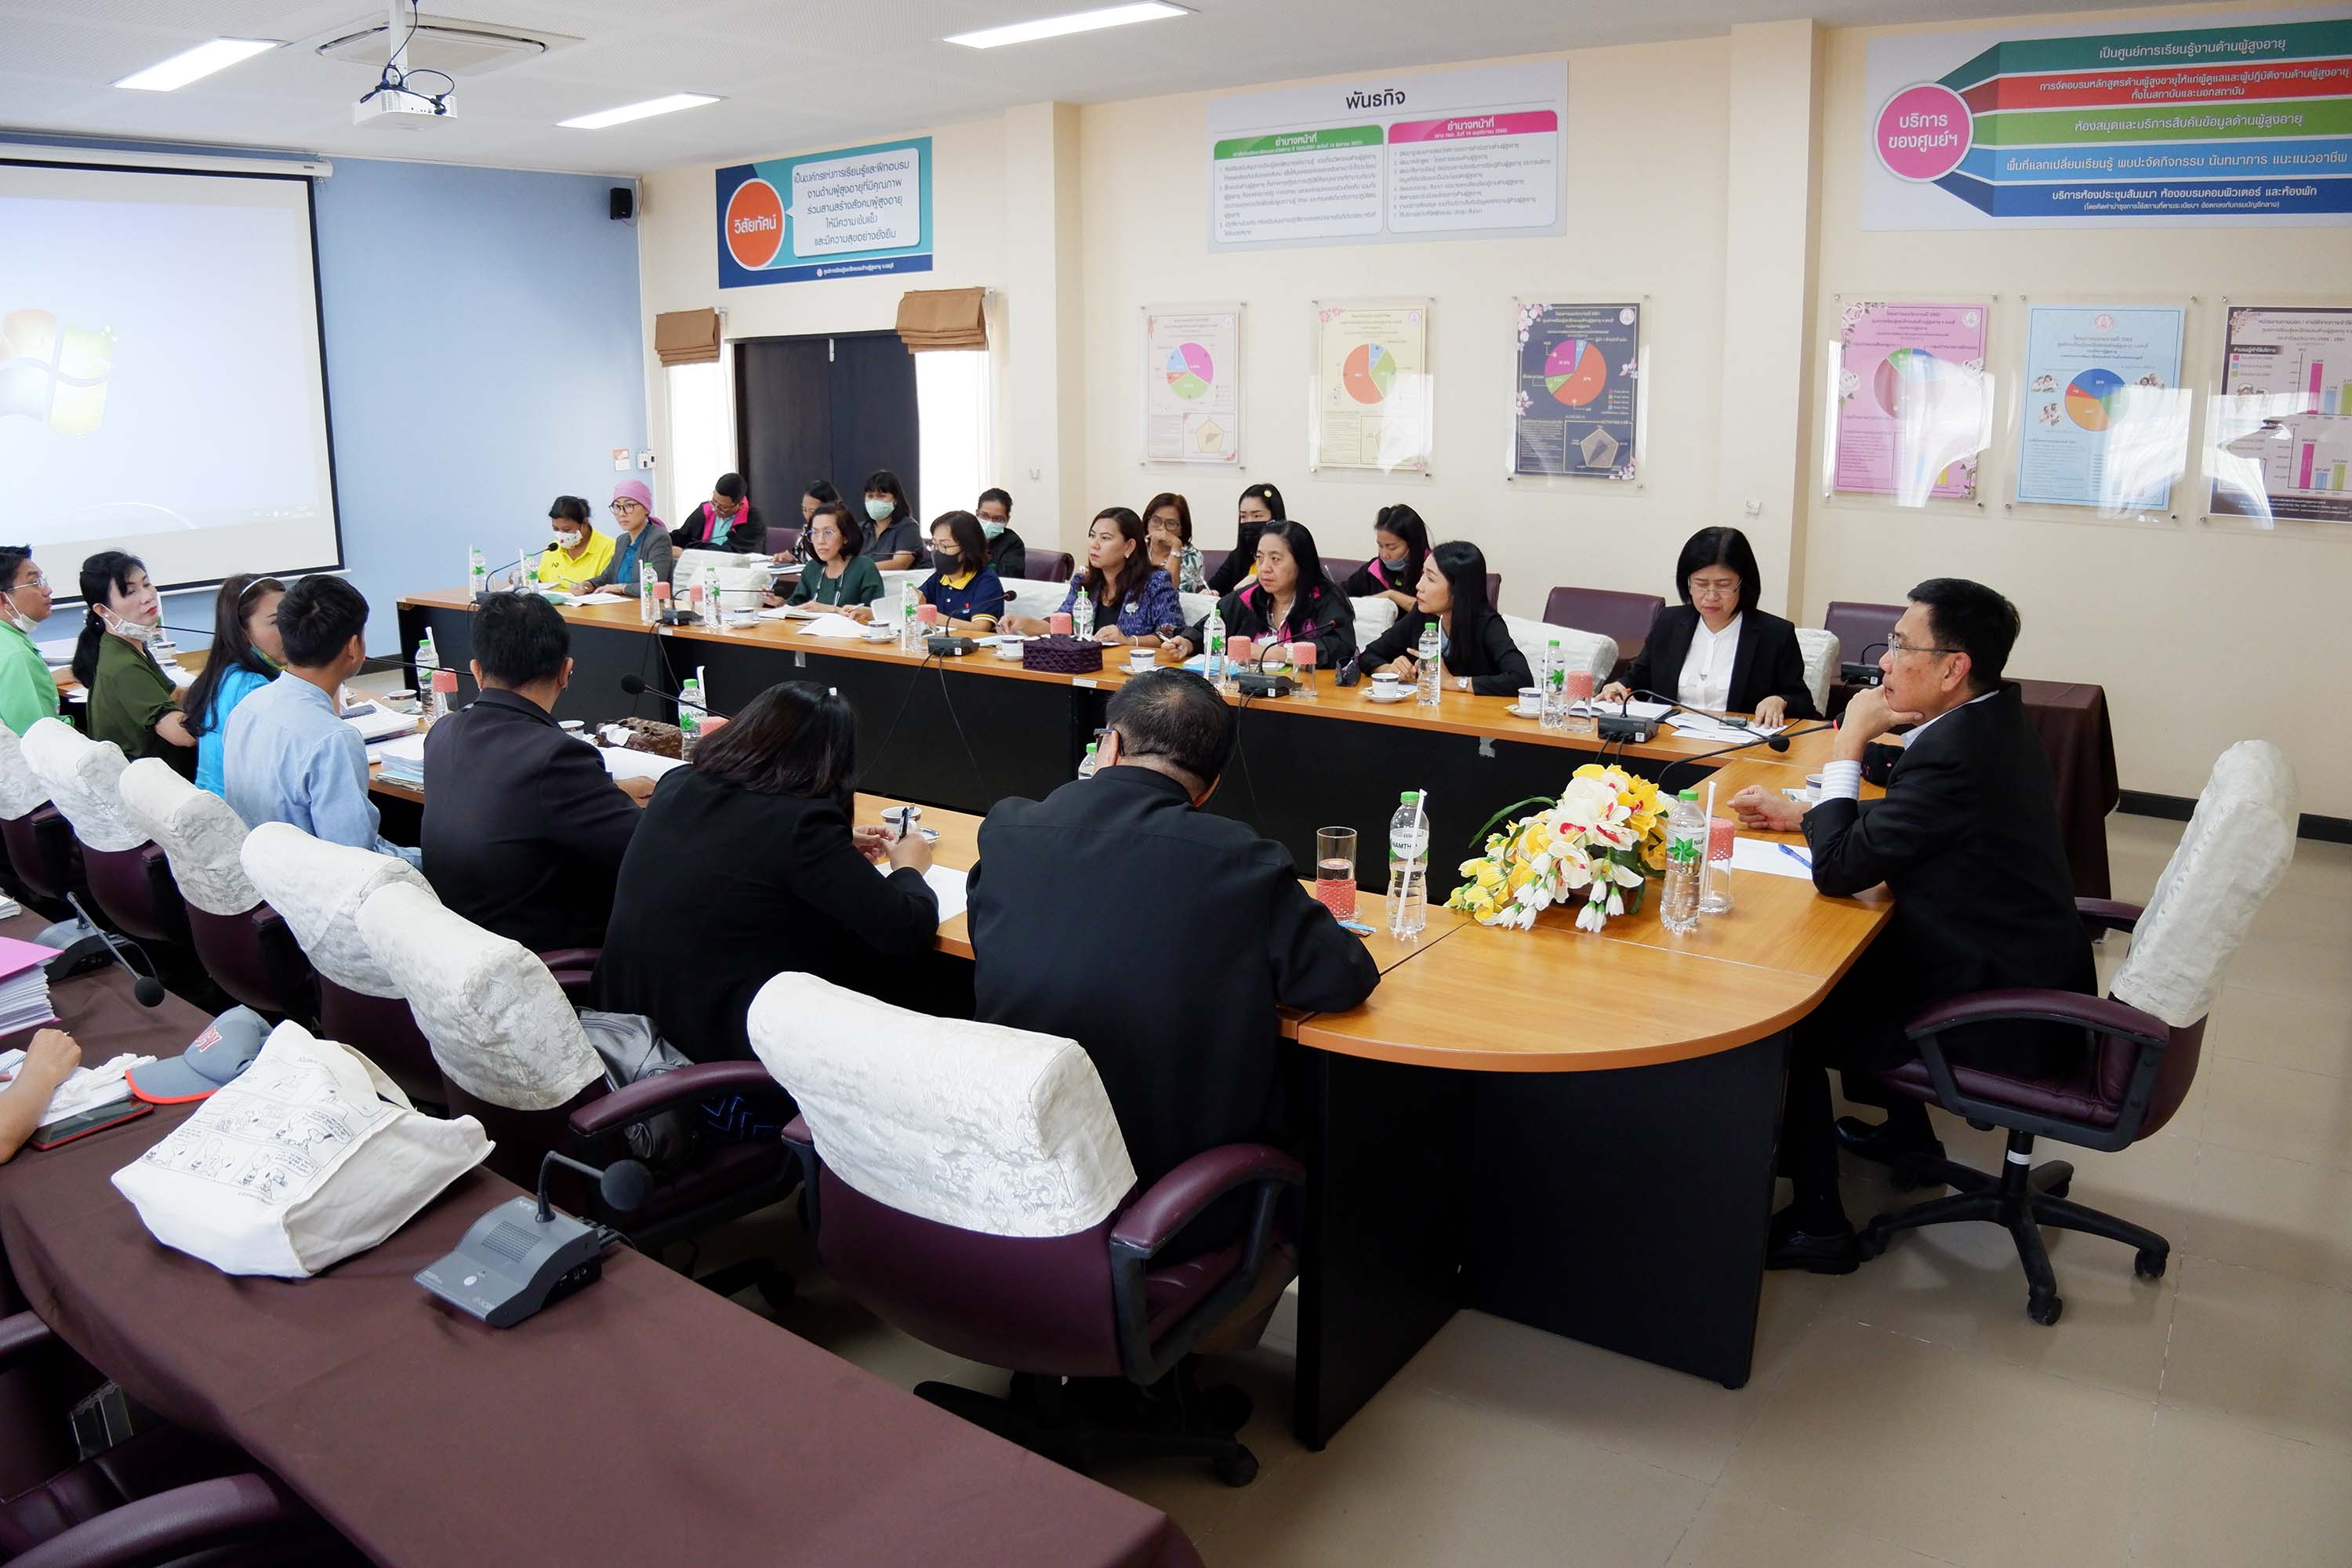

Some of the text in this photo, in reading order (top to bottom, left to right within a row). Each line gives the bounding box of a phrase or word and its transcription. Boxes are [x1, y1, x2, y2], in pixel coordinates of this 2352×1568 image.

[2099, 39, 2286, 60] เป็นศูนย์การเรียนรู้งานด้านผู้สูงอายุ
[1345, 88, 1406, 110] พันธกิจ
[2131, 86, 2245, 100] ทั้งในสถาบันและนอกสถาบัน
[1447, 115, 1495, 132] อำนาจหน้าที่
[1900, 112, 1948, 129] บริการ
[2074, 112, 2303, 134] ห้องสมุดและบริการสืบค้นข้อมูลด้านผู้สูงอายุ
[1275, 132, 1317, 147] อำนาจหน้าที่
[1888, 130, 1958, 153] ของศูนย์ฯ
[2006, 151, 2348, 172] พื้นที่แลกเปลี่ยนเรียนรู้ พบปะจัดกิจกรรม นันทนาการ แนะแนวอาชีพ
[2052, 185, 2318, 201] บริการห้องประชุมสัมมนา ห้องอบรมคอมพิวเตอร์ และห้องพัก
[734, 213, 777, 234] วิสัยทัศน์
[1392, 840, 1418, 849] NAMTH
